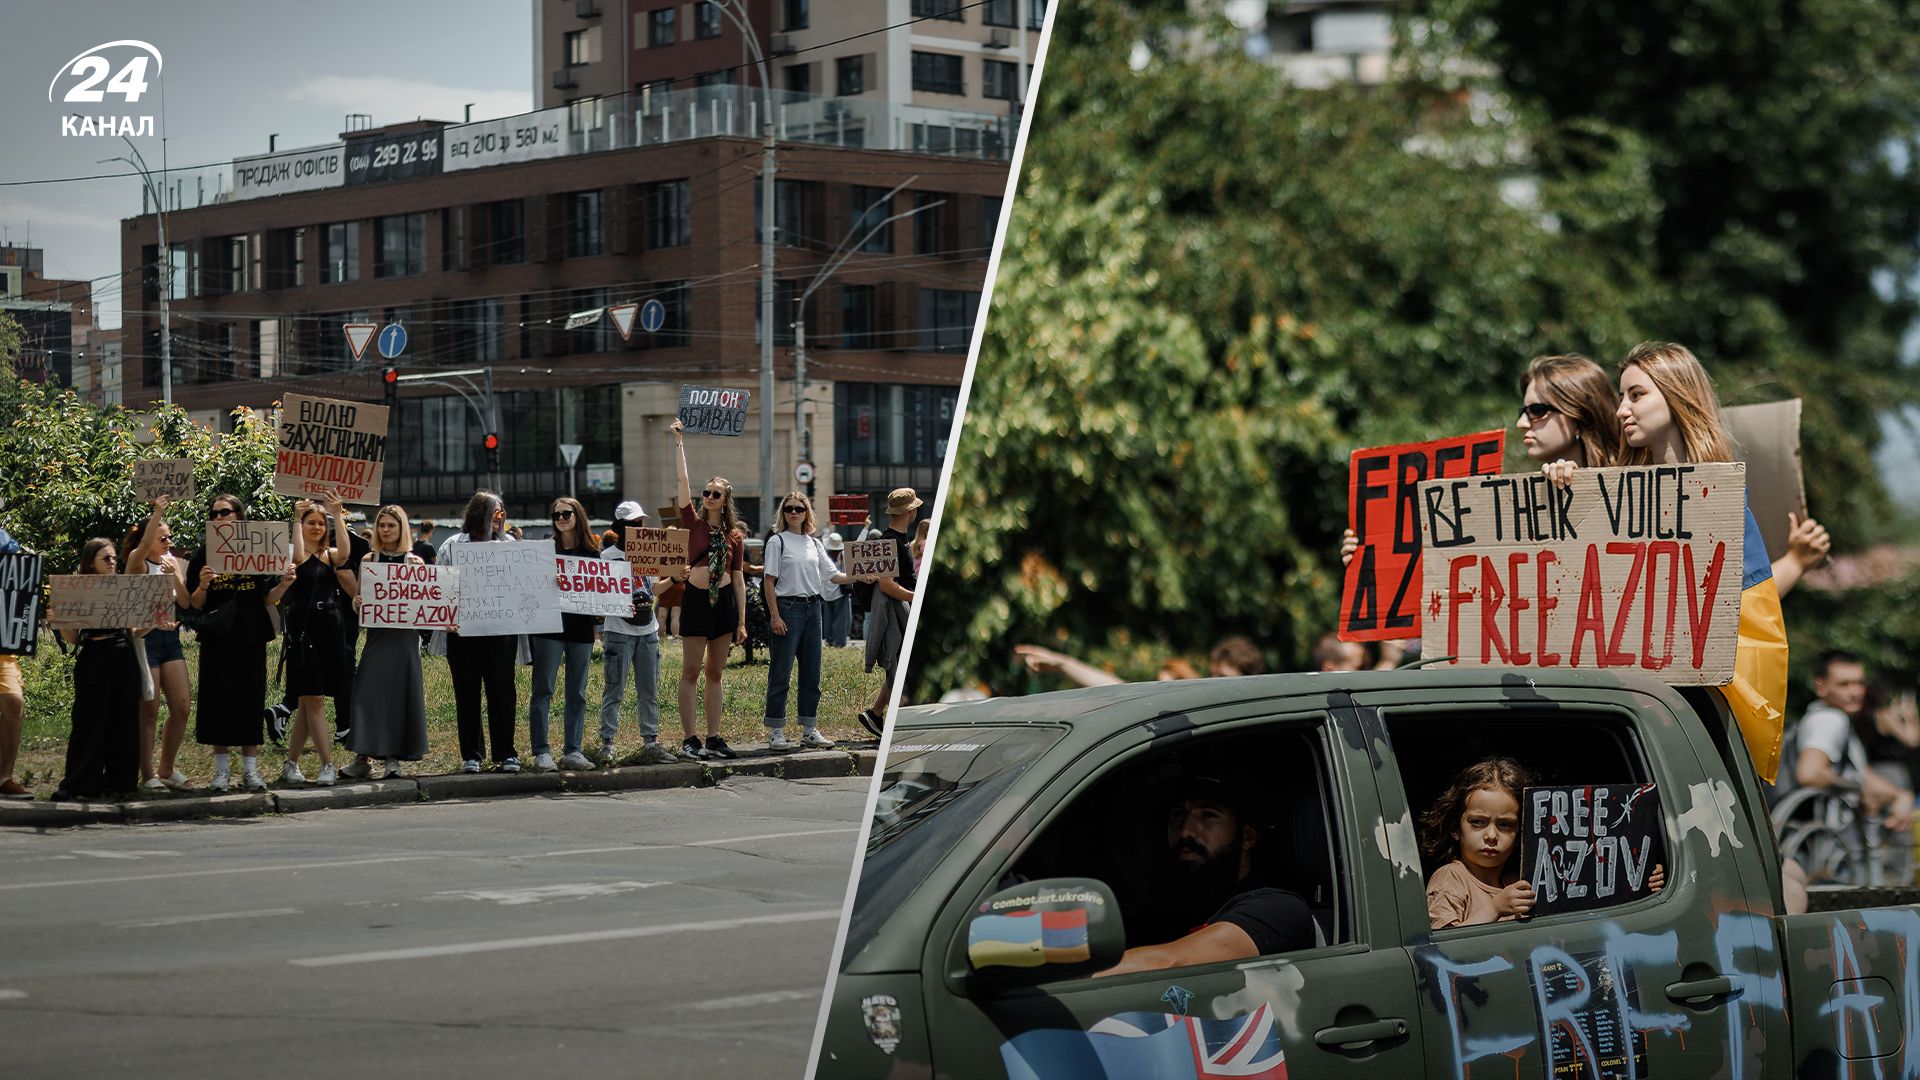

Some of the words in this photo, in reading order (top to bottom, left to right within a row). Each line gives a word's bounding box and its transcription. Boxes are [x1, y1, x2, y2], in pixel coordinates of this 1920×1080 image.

[402, 140, 418, 165] 22
[236, 161, 291, 188] ПРОДАЖ
[294, 155, 338, 178] ОФІСІВ
[689, 390, 739, 409] ПОЛОН
[299, 400, 357, 428] ВОЛЮ
[679, 407, 745, 433] ВБИВАЄ
[279, 423, 387, 463] ЗАХИСНИКАМ
[150, 461, 176, 475] ХОЧУ
[1425, 481, 1476, 548] BE
[1480, 474, 1577, 542] THEIR
[1597, 466, 1695, 540] VOICE
[636, 529, 667, 541] КРИЧИ
[455, 550, 496, 566] ВОНИ
[627, 555, 658, 565] ГОЛОСУ
[850, 542, 892, 559] FREE
[224, 554, 287, 572] ПОЛОНУ
[386, 563, 438, 582] ПОЛОН
[851, 558, 897, 576] AZOV
[373, 581, 442, 601] ВБИВАЄ
[559, 574, 632, 595] ВБИВАЄ
[361, 603, 408, 625] FREE
[412, 604, 458, 626] AZOV
[1570, 541, 1726, 670] AZOV
[1533, 788, 1609, 838] FREE
[1531, 835, 1651, 903] AZOV
